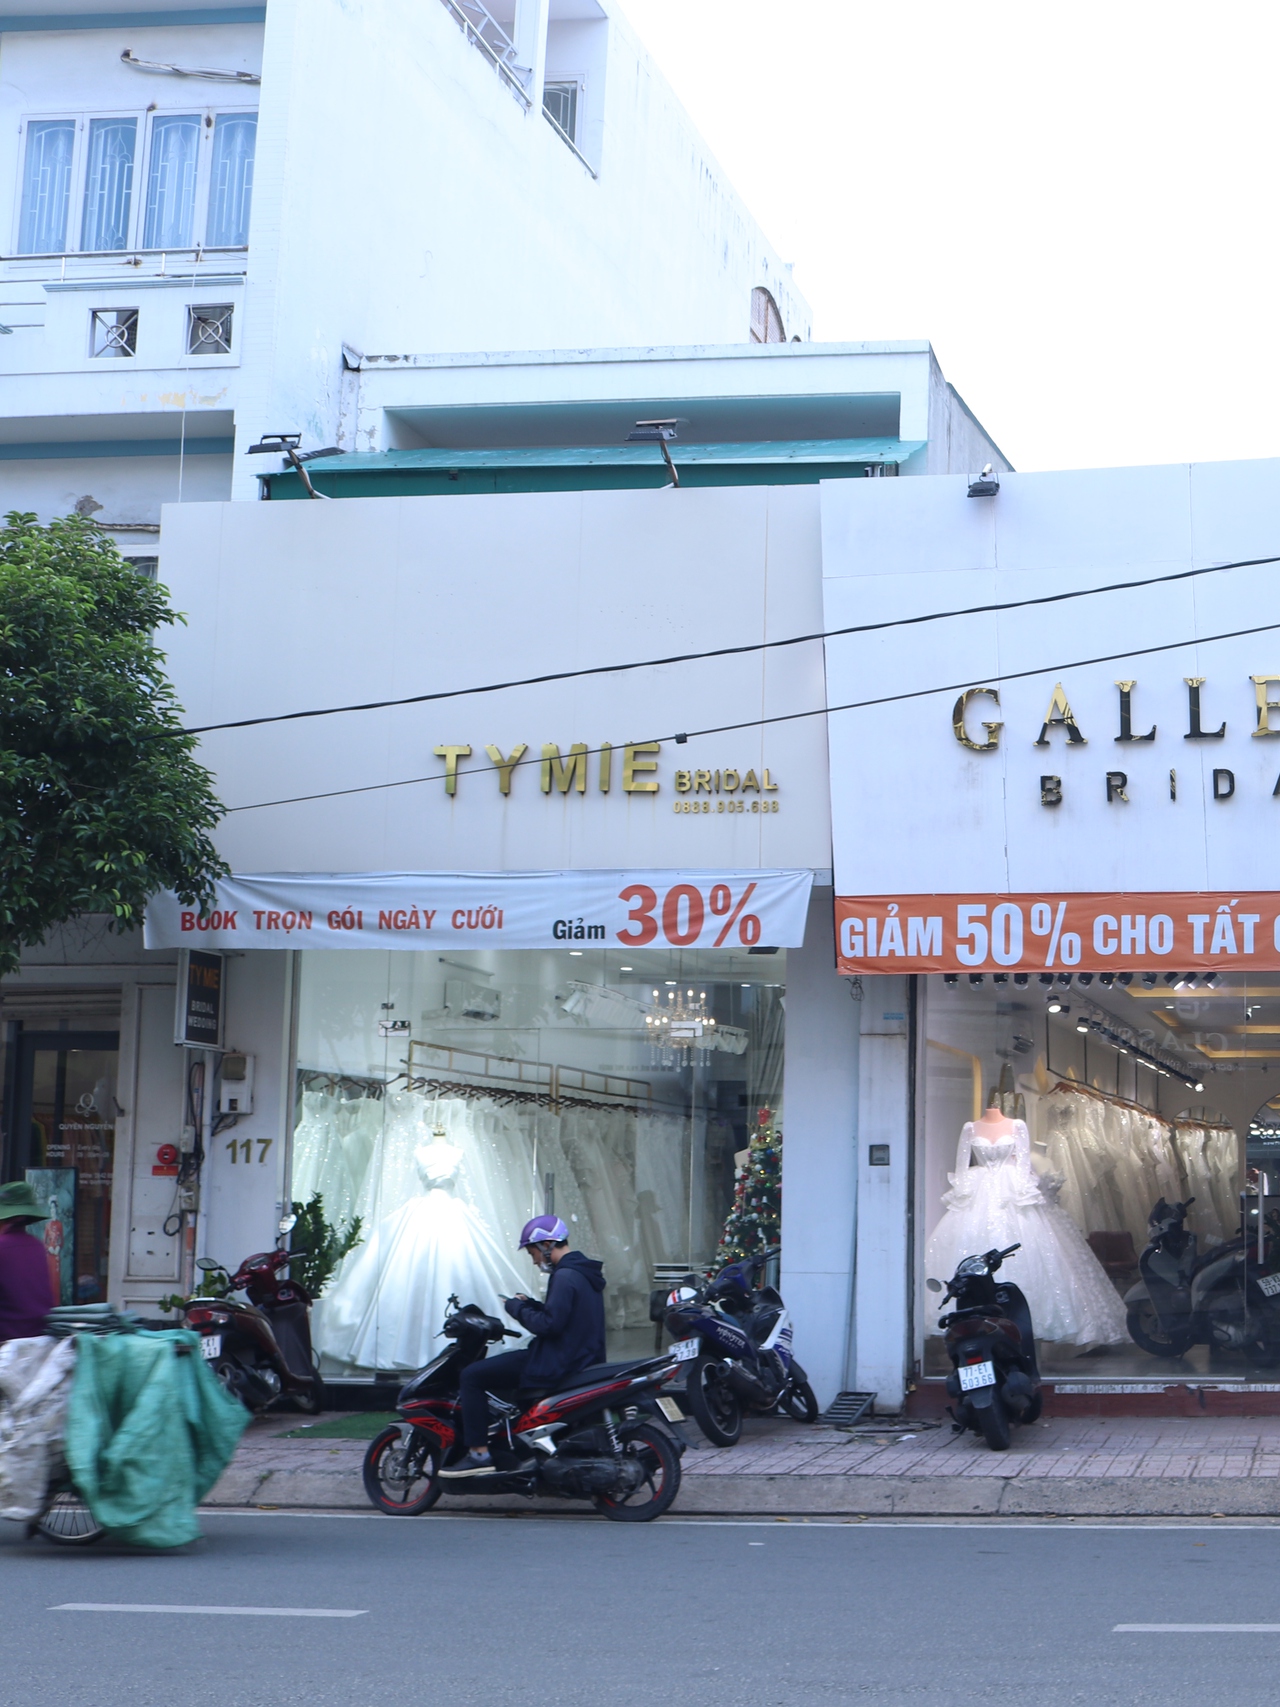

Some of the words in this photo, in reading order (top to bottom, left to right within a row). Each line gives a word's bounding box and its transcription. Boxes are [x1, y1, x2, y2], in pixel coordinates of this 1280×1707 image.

[433, 741, 661, 796] TYMIE
[674, 768, 779, 794] BRIDAL
[181, 909, 238, 931] BOOK
[253, 910, 312, 934] TRỌN
[327, 905, 363, 931] GÓI
[378, 904, 437, 930] NGÀY
[451, 904, 504, 930] CƯỚI
[552, 917, 606, 940] Giảm
[615, 882, 762, 948] 30%
[840, 903, 944, 958] GIẢM
[955, 901, 1082, 967] 50%
[1092, 914, 1174, 955] CHO
[1187, 899, 1261, 955] TẤT
[226, 1138, 272, 1164] 117
